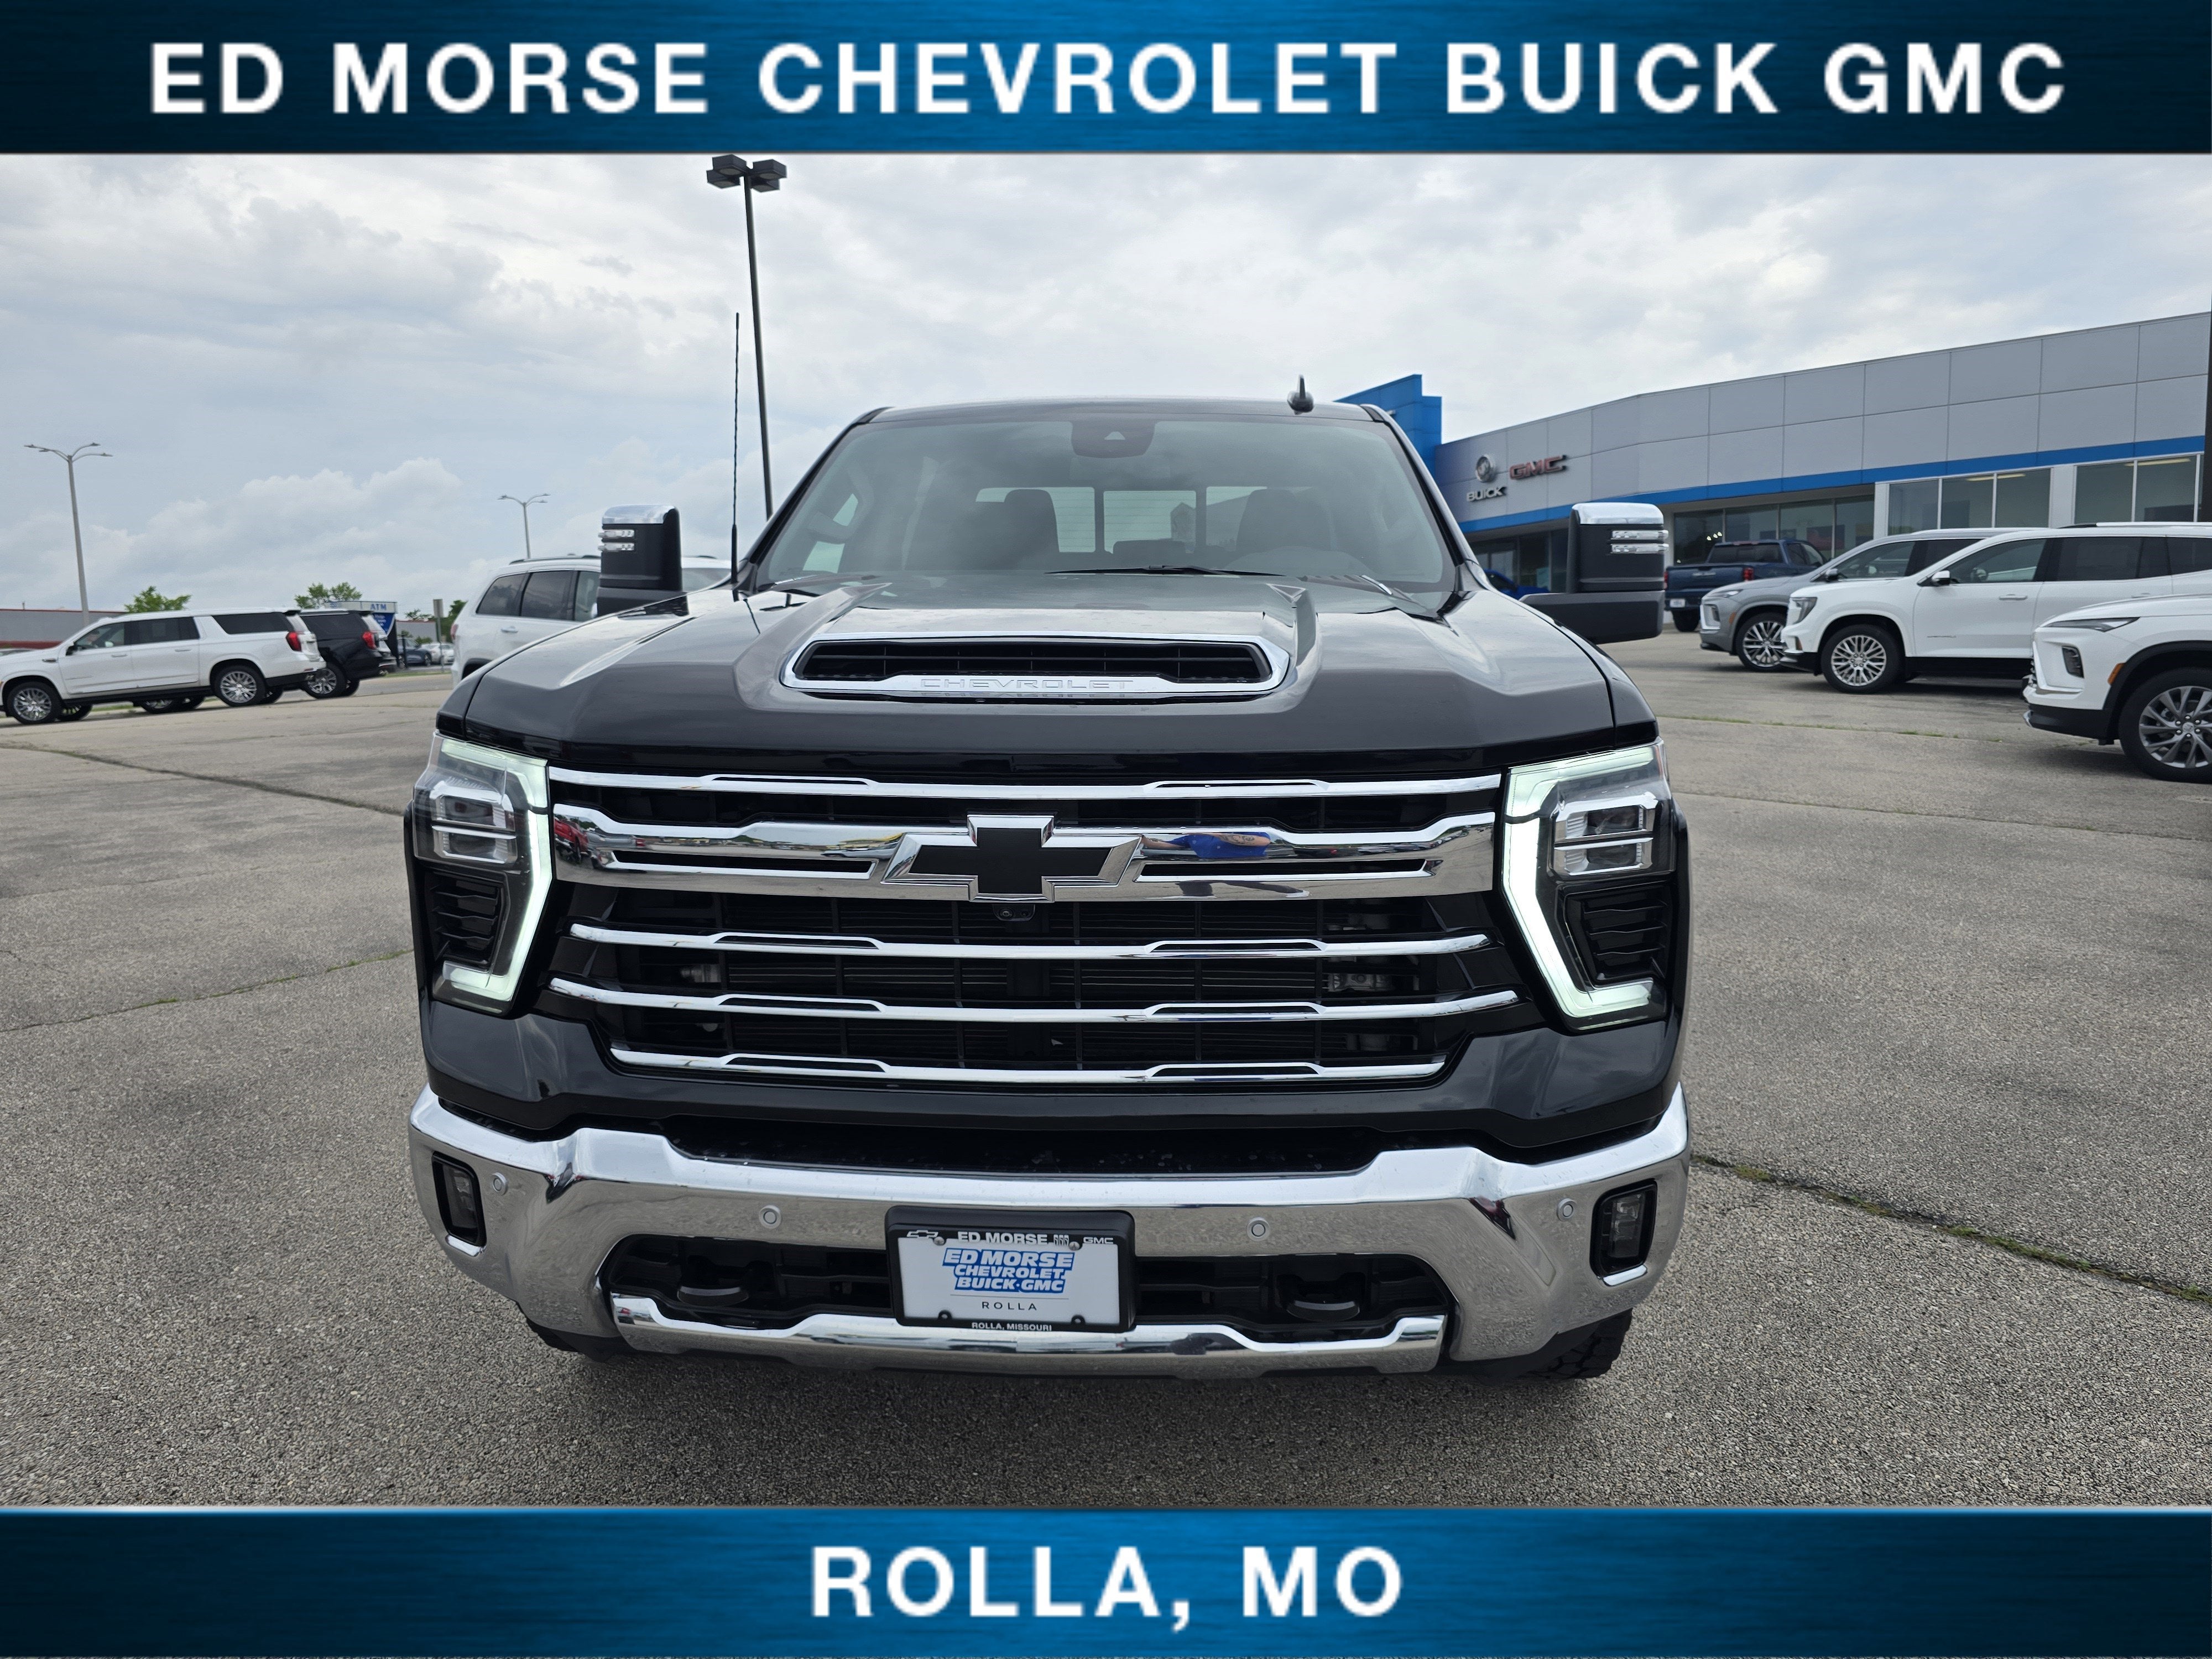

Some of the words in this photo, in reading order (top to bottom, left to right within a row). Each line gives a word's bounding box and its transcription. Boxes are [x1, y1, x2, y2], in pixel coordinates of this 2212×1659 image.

[1509, 455, 1566, 480] GMC
[1467, 487, 1504, 502] BUICK
[921, 679, 1134, 689] CHEVROLET
[957, 1231, 981, 1243] ED
[985, 1232, 1048, 1245] MORSE
[943, 1249, 979, 1265] ED
[980, 1250, 1074, 1269] MORSE
[982, 1301, 1037, 1311] ROLLA
[971, 1322, 1005, 1331] ROLLA,
[1006, 1323, 1053, 1331] MISSOURI
